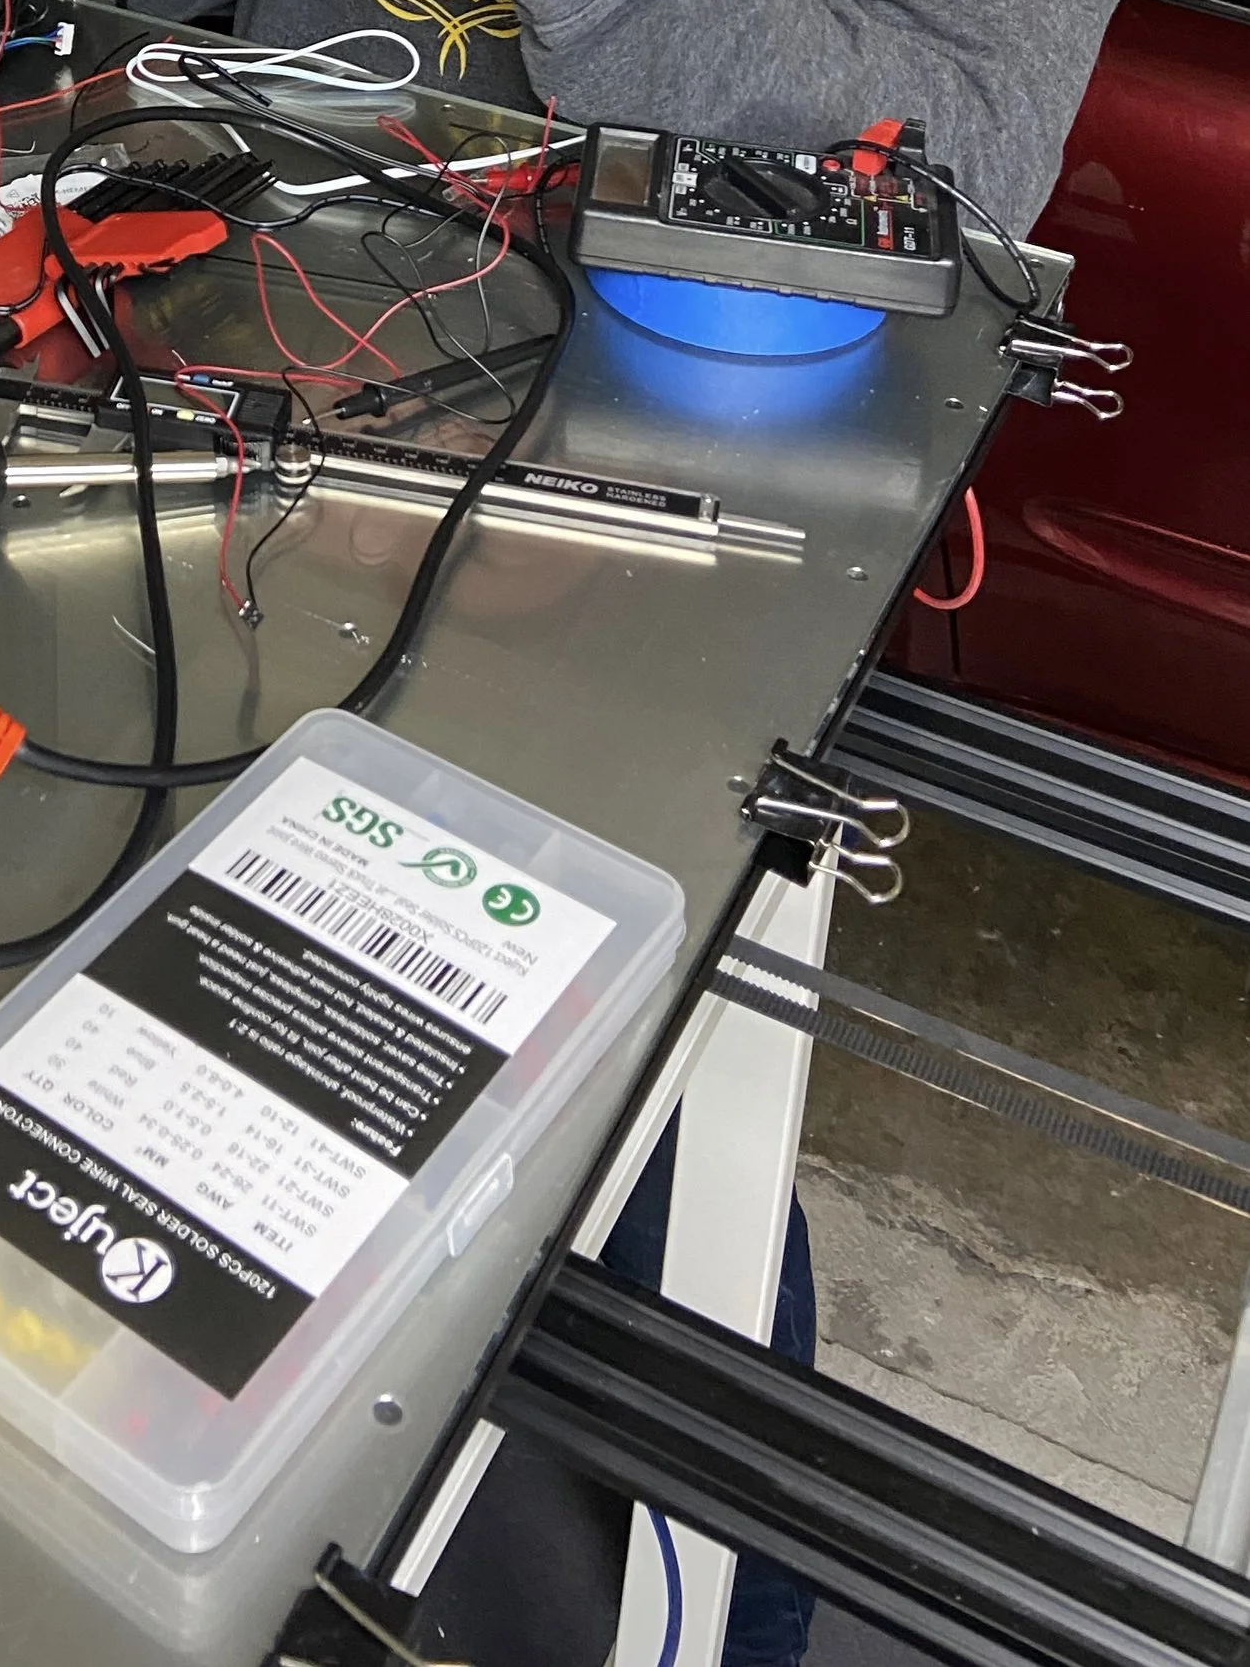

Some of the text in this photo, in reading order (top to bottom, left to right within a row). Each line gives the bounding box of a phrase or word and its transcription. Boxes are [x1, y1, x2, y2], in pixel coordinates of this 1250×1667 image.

[524, 472, 599, 495] NEIKO
[607, 485, 668, 503] STAINLESS
[278, 814, 370, 867] MADE IN CHINA
[317, 793, 407, 851] SGS
[498, 938, 540, 966] New
[322, 1030, 367, 1060] sleeve
[21, 1066, 57, 1092] QTY
[347, 1069, 380, 1092] bent
[359, 1052, 436, 1103] Transparent
[374, 1085, 396, 1102] be
[59, 1091, 116, 1131] COLOR
[390, 1095, 422, 1119] Can
[346, 1116, 404, 1157] Feature:
[77, 1156, 121, 1189] WIRE
[306, 1136, 369, 1180] SWT-41
[193, 1180, 236, 1211] AWG
[274, 1173, 337, 1218] SWT-21
[290, 1155, 352, 1199] SWT-31
[115, 1181, 161, 1215] SEAL
[258, 1192, 321, 1237] SWT-11
[9, 1167, 174, 1303] Kuject
[153, 1208, 223, 1259] SOLDER
[251, 1219, 295, 1252] ITEM
[213, 1250, 281, 1300] 120PCS
